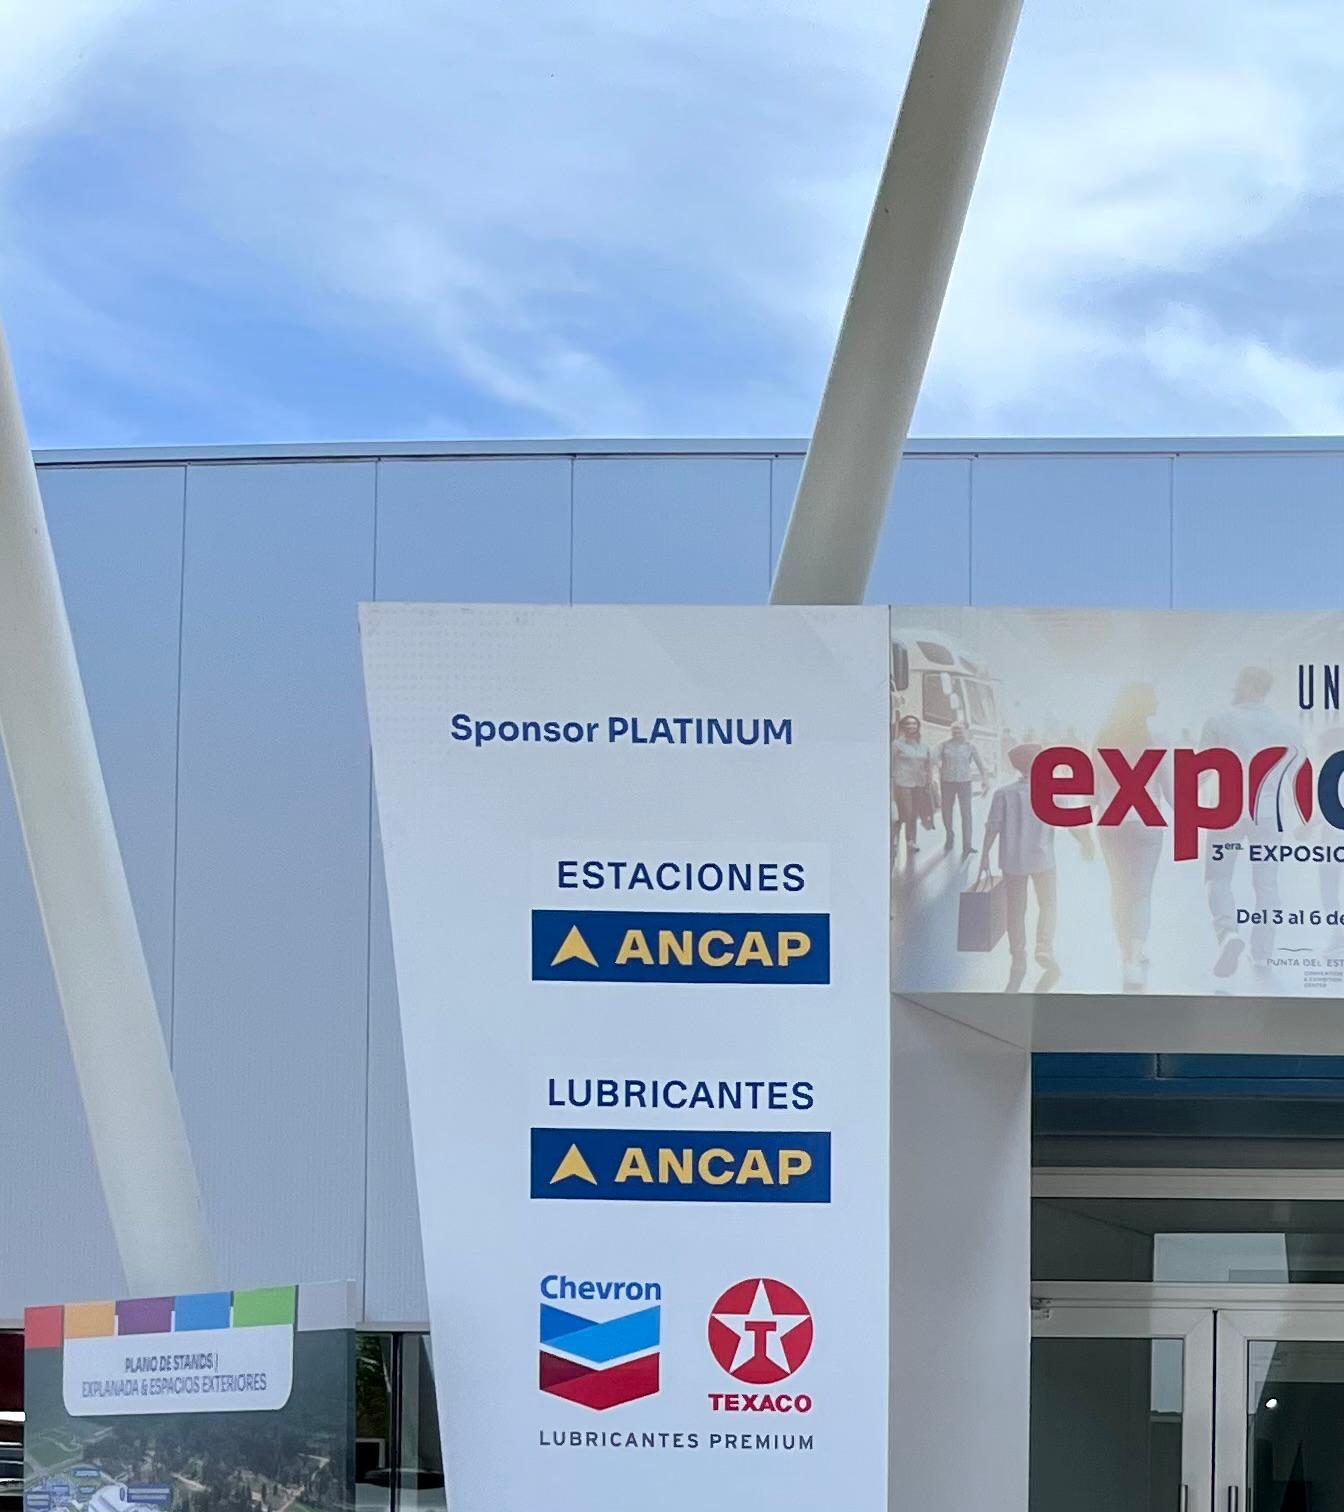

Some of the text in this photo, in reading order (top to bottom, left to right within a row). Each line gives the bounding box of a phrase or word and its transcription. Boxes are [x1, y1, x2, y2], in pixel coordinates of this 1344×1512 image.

[450, 713, 793, 747] Sponsor PLATINUM
[557, 860, 806, 892] ESTACIONES
[1236, 909, 1267, 925] Del
[1272, 910, 1284, 925] 3
[1288, 909, 1304, 925] al
[1310, 910, 1322, 925] 6
[615, 928, 813, 968] ANCAP
[547, 1078, 814, 1110] LUBRICANTES
[614, 1147, 813, 1186] ANCAP
[540, 1275, 661, 1300] Chevron
[125, 1356, 157, 1373] PLANO
[159, 1355, 172, 1371] DE
[174, 1353, 213, 1371] STANDS
[150, 1376, 200, 1395] ESPACIOS
[202, 1373, 267, 1393] EXTERIORES
[708, 1393, 813, 1413] TEXACO
[539, 1430, 814, 1450] LUBRICANTES PREMIUM
